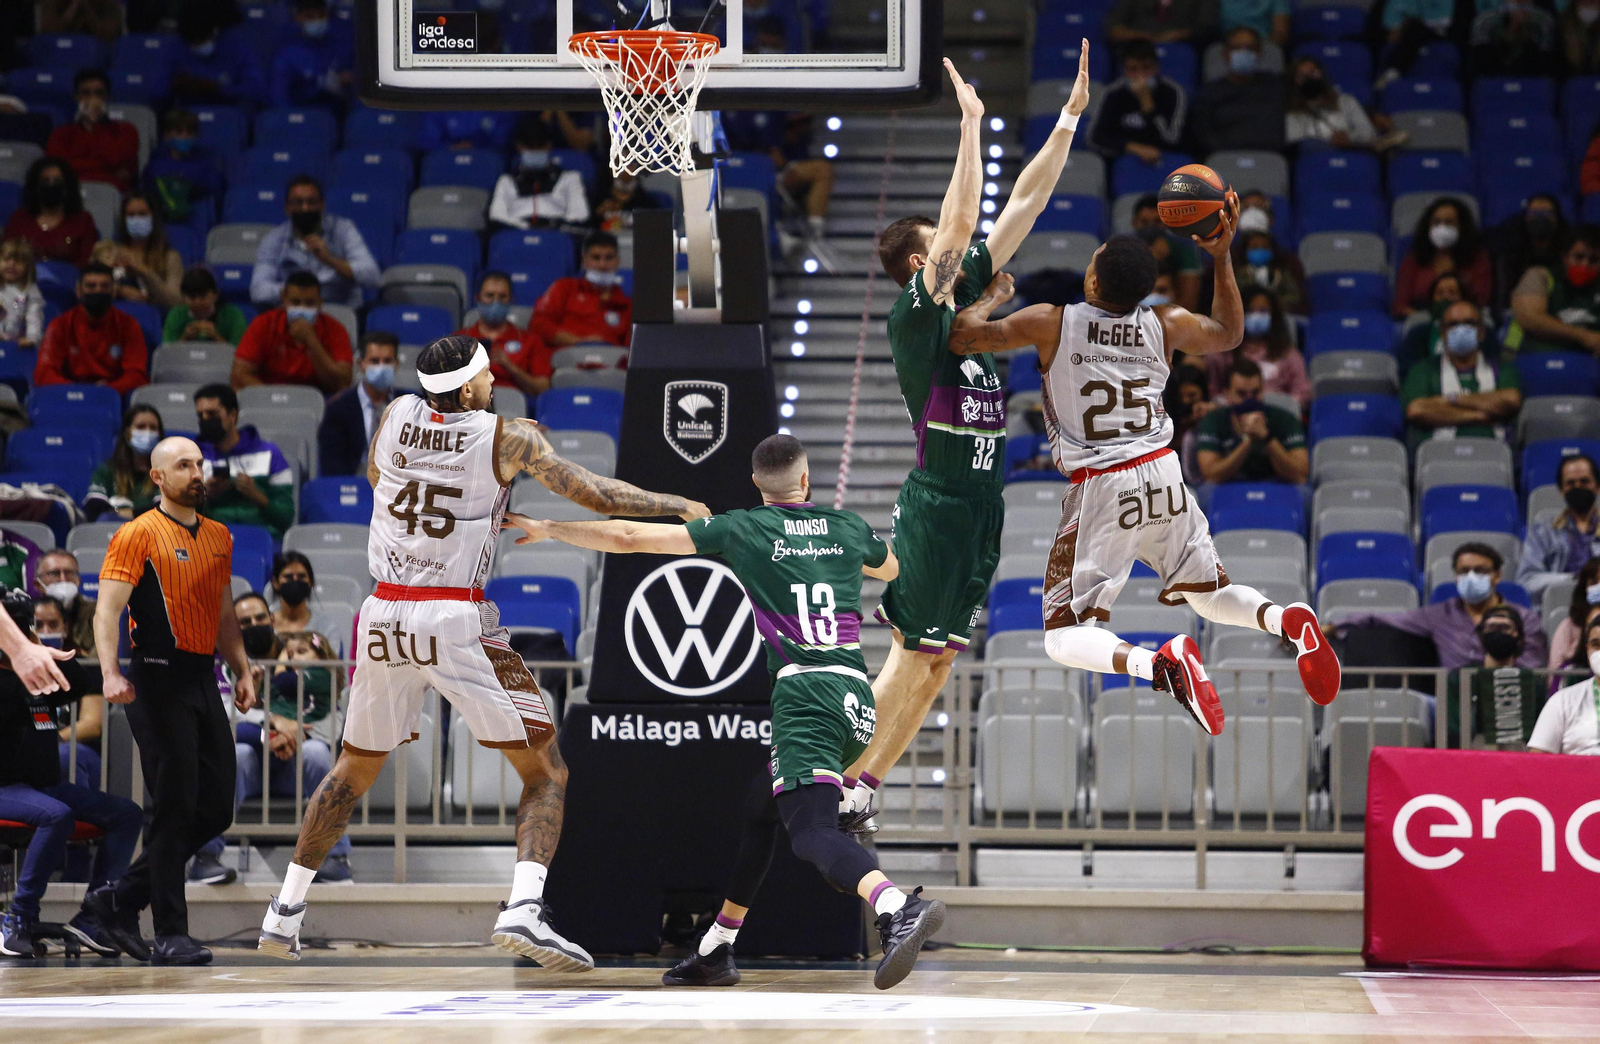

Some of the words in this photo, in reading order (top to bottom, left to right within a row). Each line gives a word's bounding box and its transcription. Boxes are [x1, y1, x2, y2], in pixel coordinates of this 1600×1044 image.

[418, 22, 444, 38] liga
[418, 35, 474, 49] endesa
[1087, 321, 1145, 347] McGEE
[1083, 355, 1118, 363] GRUPO
[1120, 356, 1159, 364] HEREDA
[1080, 377, 1152, 441] 25
[677, 420, 713, 432] Unicaja
[398, 422, 468, 453] GAMBLE
[972, 437, 996, 470] 32
[408, 460, 434, 469] GRUPO
[435, 463, 466, 472] HEREDA
[1118, 486, 1142, 499] GRUPO
[387, 479, 463, 540] 45
[1118, 481, 1188, 530] atu
[783, 518, 829, 536] ALONSO
[406, 554, 448, 572] Recoletas
[369, 621, 391, 629] GRUPO
[790, 582, 838, 646] 13
[367, 620, 438, 666] atu
[591, 714, 701, 746] Málaga
